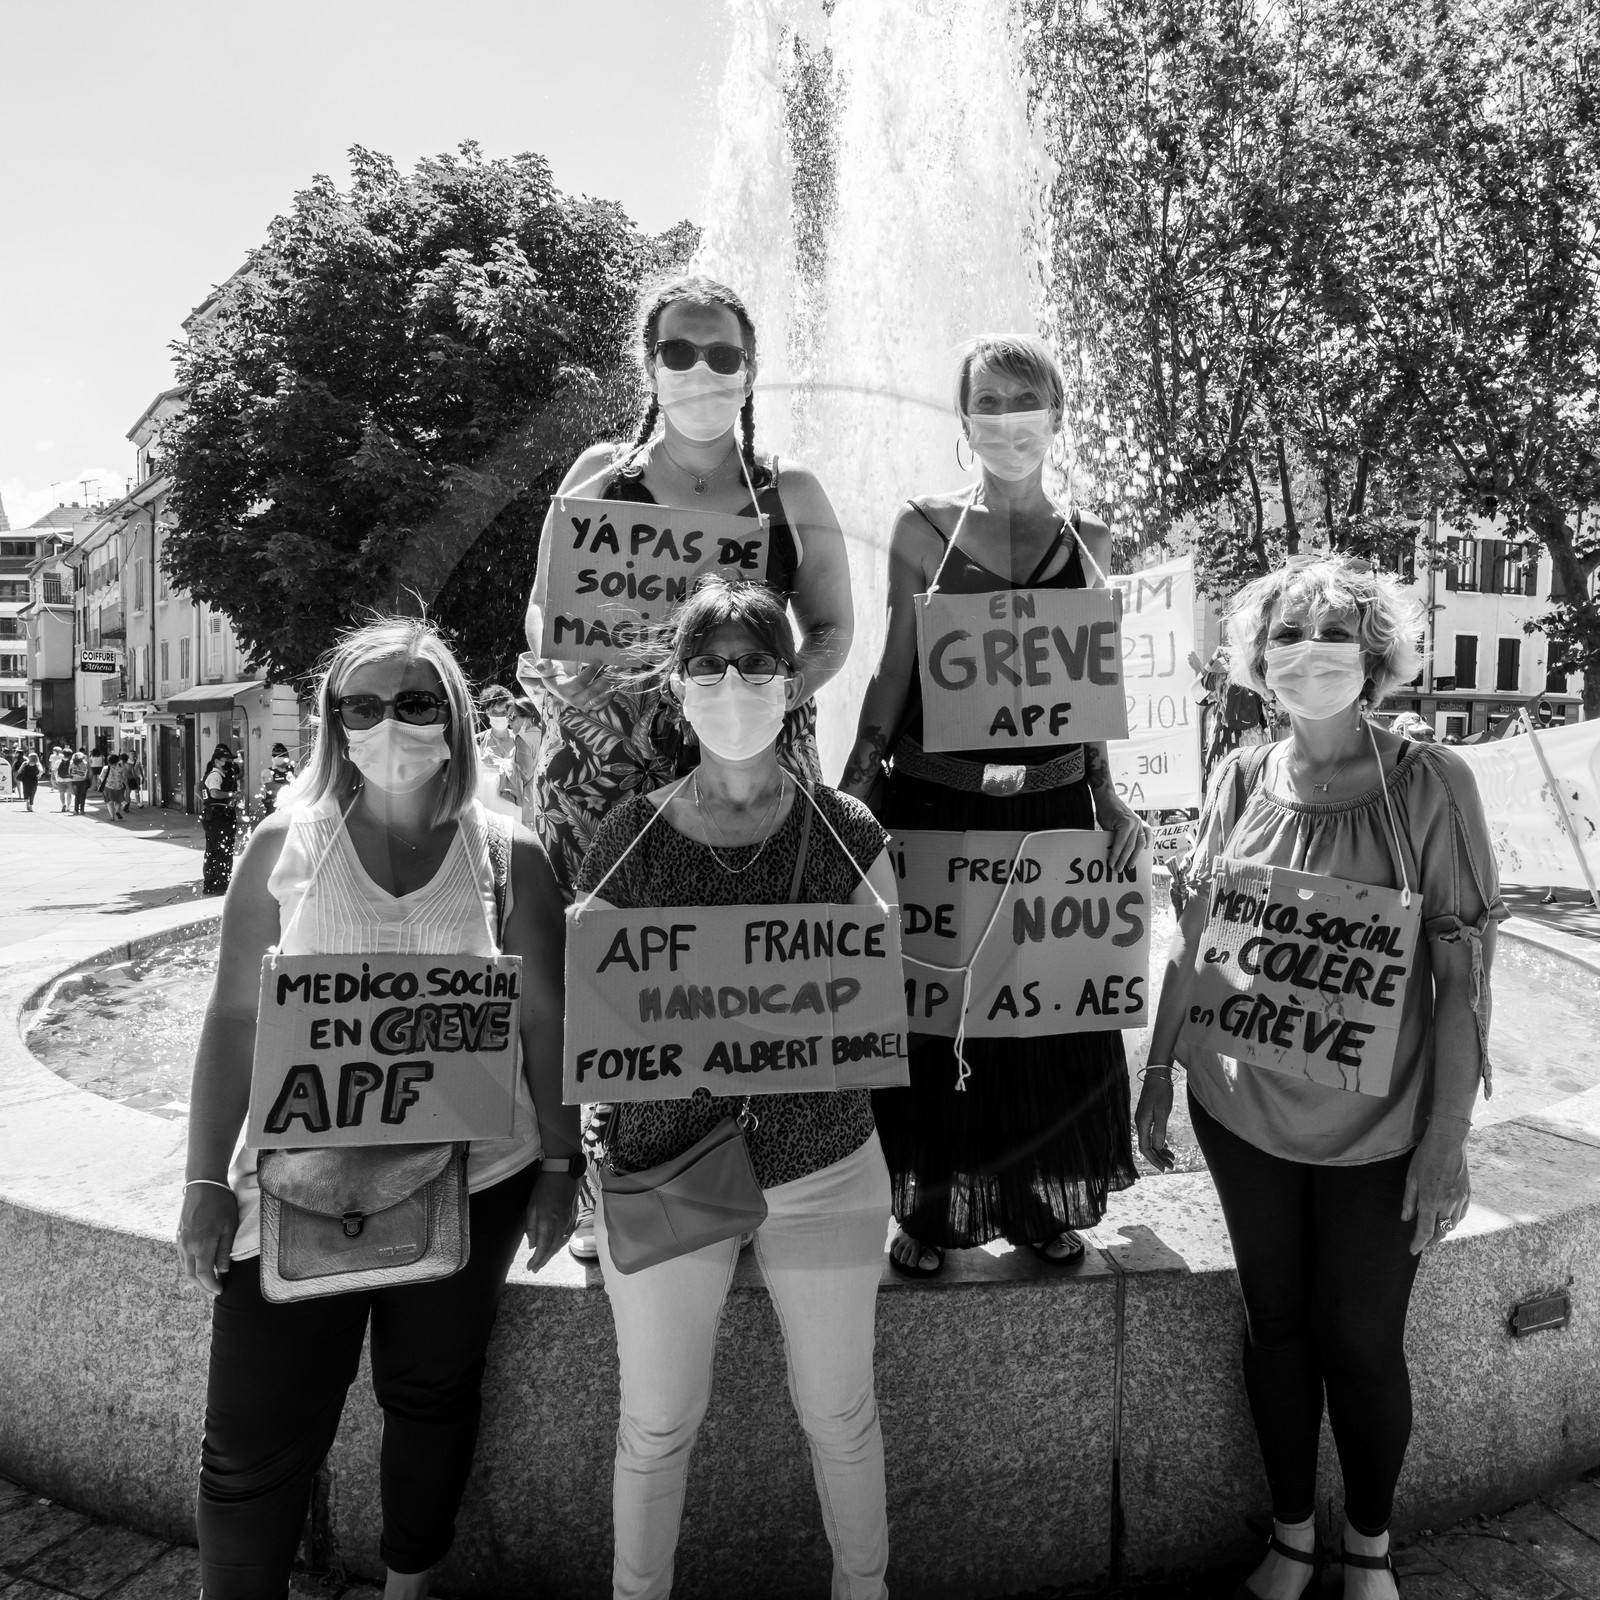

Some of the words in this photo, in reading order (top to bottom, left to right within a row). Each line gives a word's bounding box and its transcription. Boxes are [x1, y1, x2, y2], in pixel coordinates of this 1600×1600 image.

[630, 524, 704, 564] PAS
[717, 538, 762, 569] DE
[988, 593, 1036, 619] EN
[82, 651, 115, 662] COIFFURE
[929, 621, 1120, 691] GREVE
[989, 702, 1073, 737] APF
[1152, 824, 1190, 837] TALIER
[1153, 838, 1178, 850] NCE
[948, 857, 1042, 885] PREND
[903, 903, 958, 939] DE
[1012, 890, 1145, 948] NOUS
[596, 924, 698, 974] APF
[744, 918, 886, 965] FRANCE
[1203, 947, 1231, 965] en
[1237, 936, 1407, 1008] COLÈRE
[638, 976, 862, 1023] HANDICAP
[1075, 975, 1145, 1017] AES
[310, 1017, 363, 1050] EN
[370, 1002, 513, 1056] GREVE
[1190, 1005, 1215, 1027] en
[1219, 992, 1376, 1067] GRÈVE
[575, 1043, 684, 1083] FOYER
[703, 1035, 823, 1075] ALBERT
[832, 1032, 909, 1066] BOREL
[263, 1060, 435, 1134] APF
